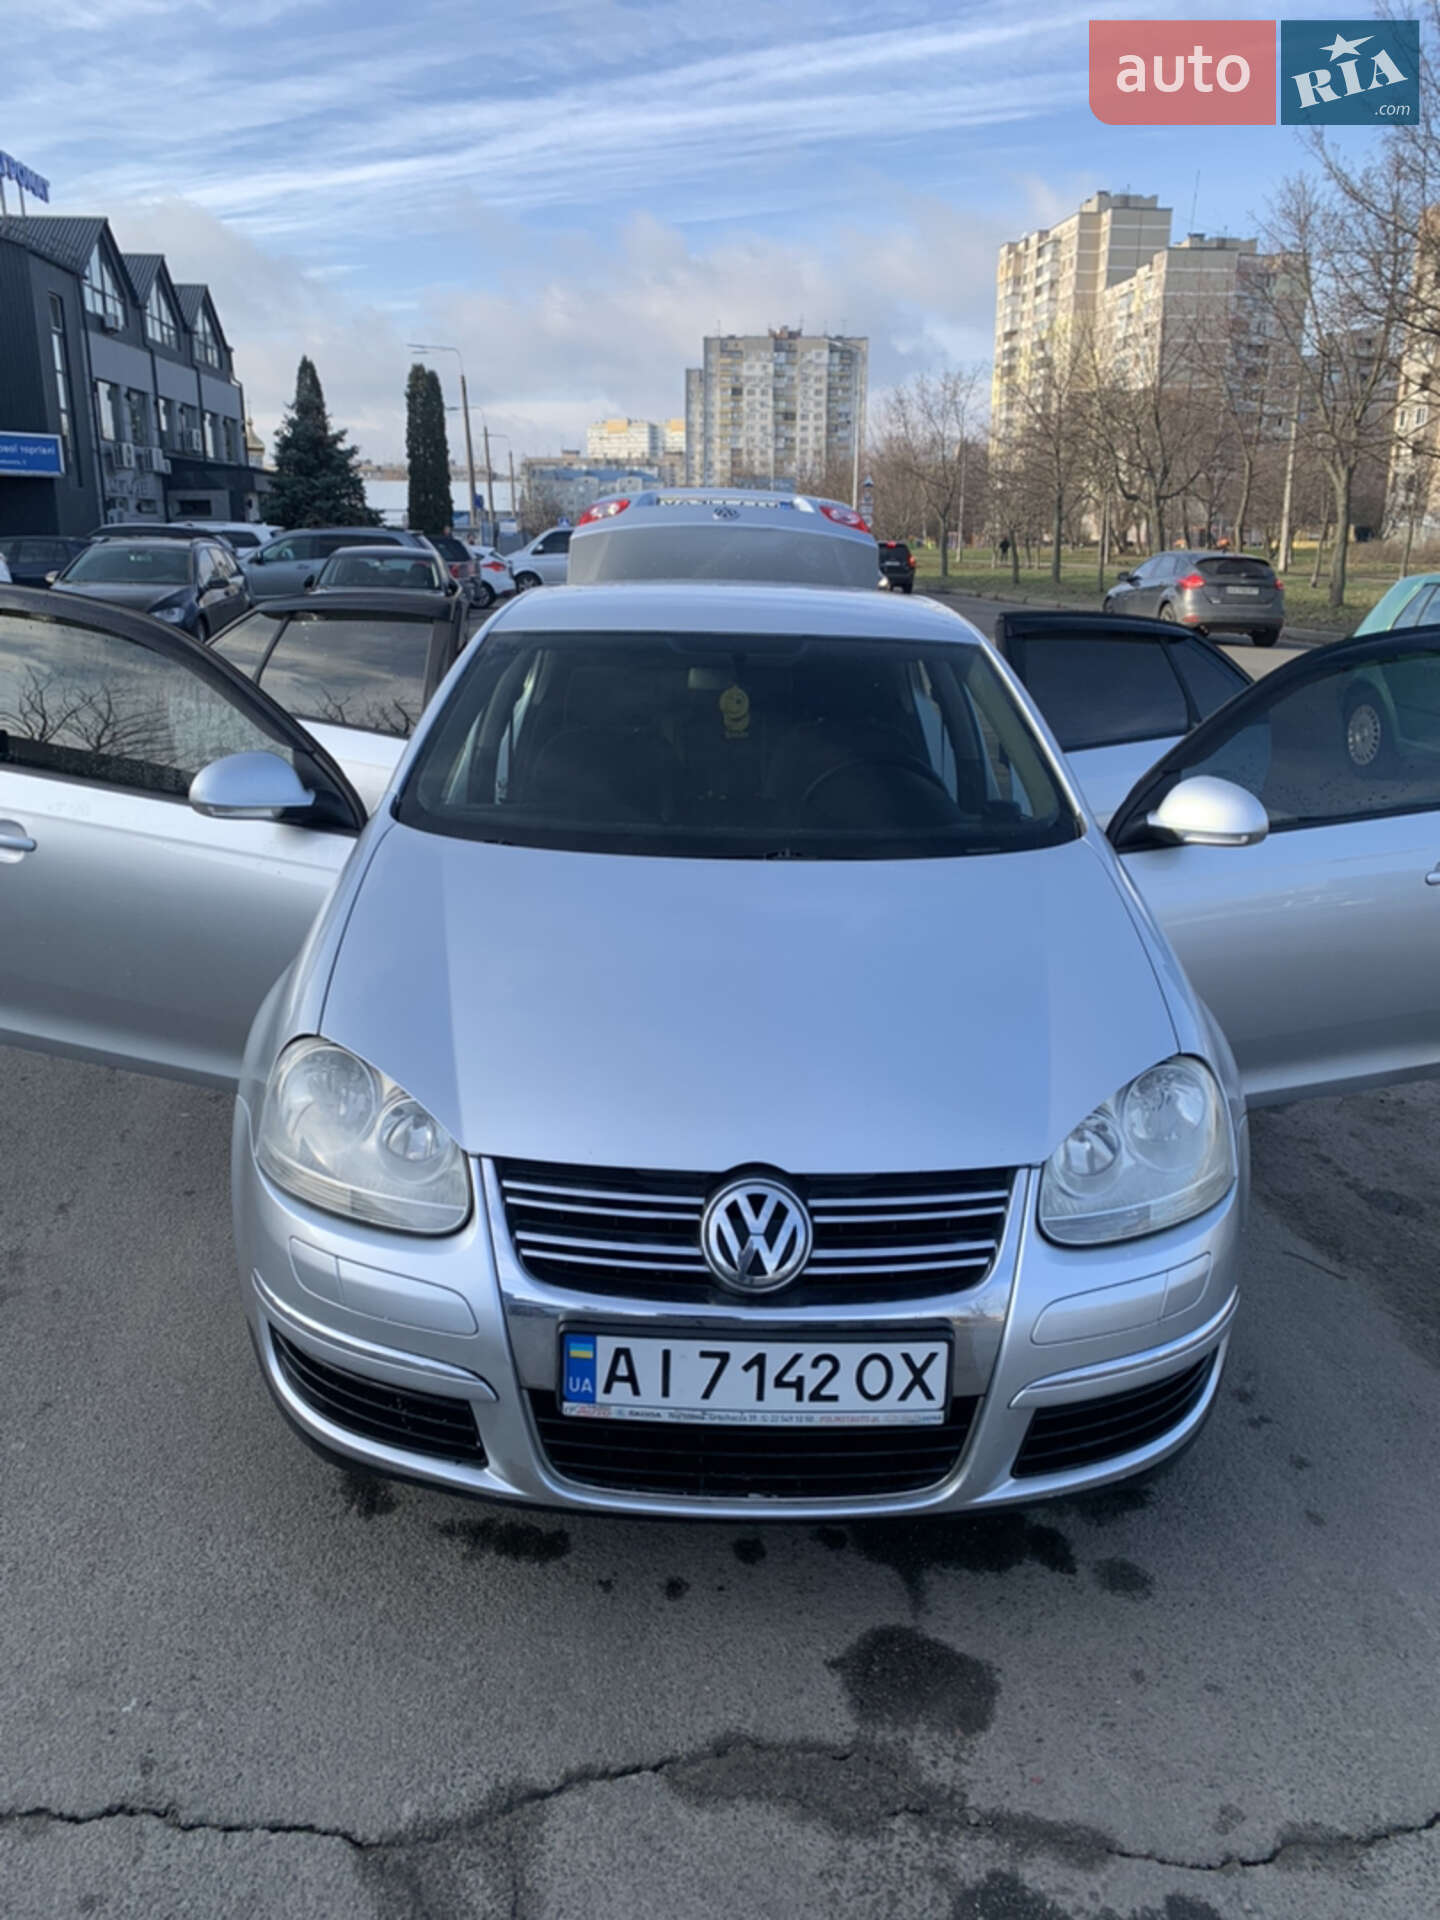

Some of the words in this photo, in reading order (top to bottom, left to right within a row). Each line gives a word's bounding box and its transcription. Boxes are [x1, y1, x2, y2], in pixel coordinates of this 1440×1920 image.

[568, 1376, 593, 1393] UA
[699, 1350, 841, 1403] 7142
[855, 1351, 940, 1402] OX
